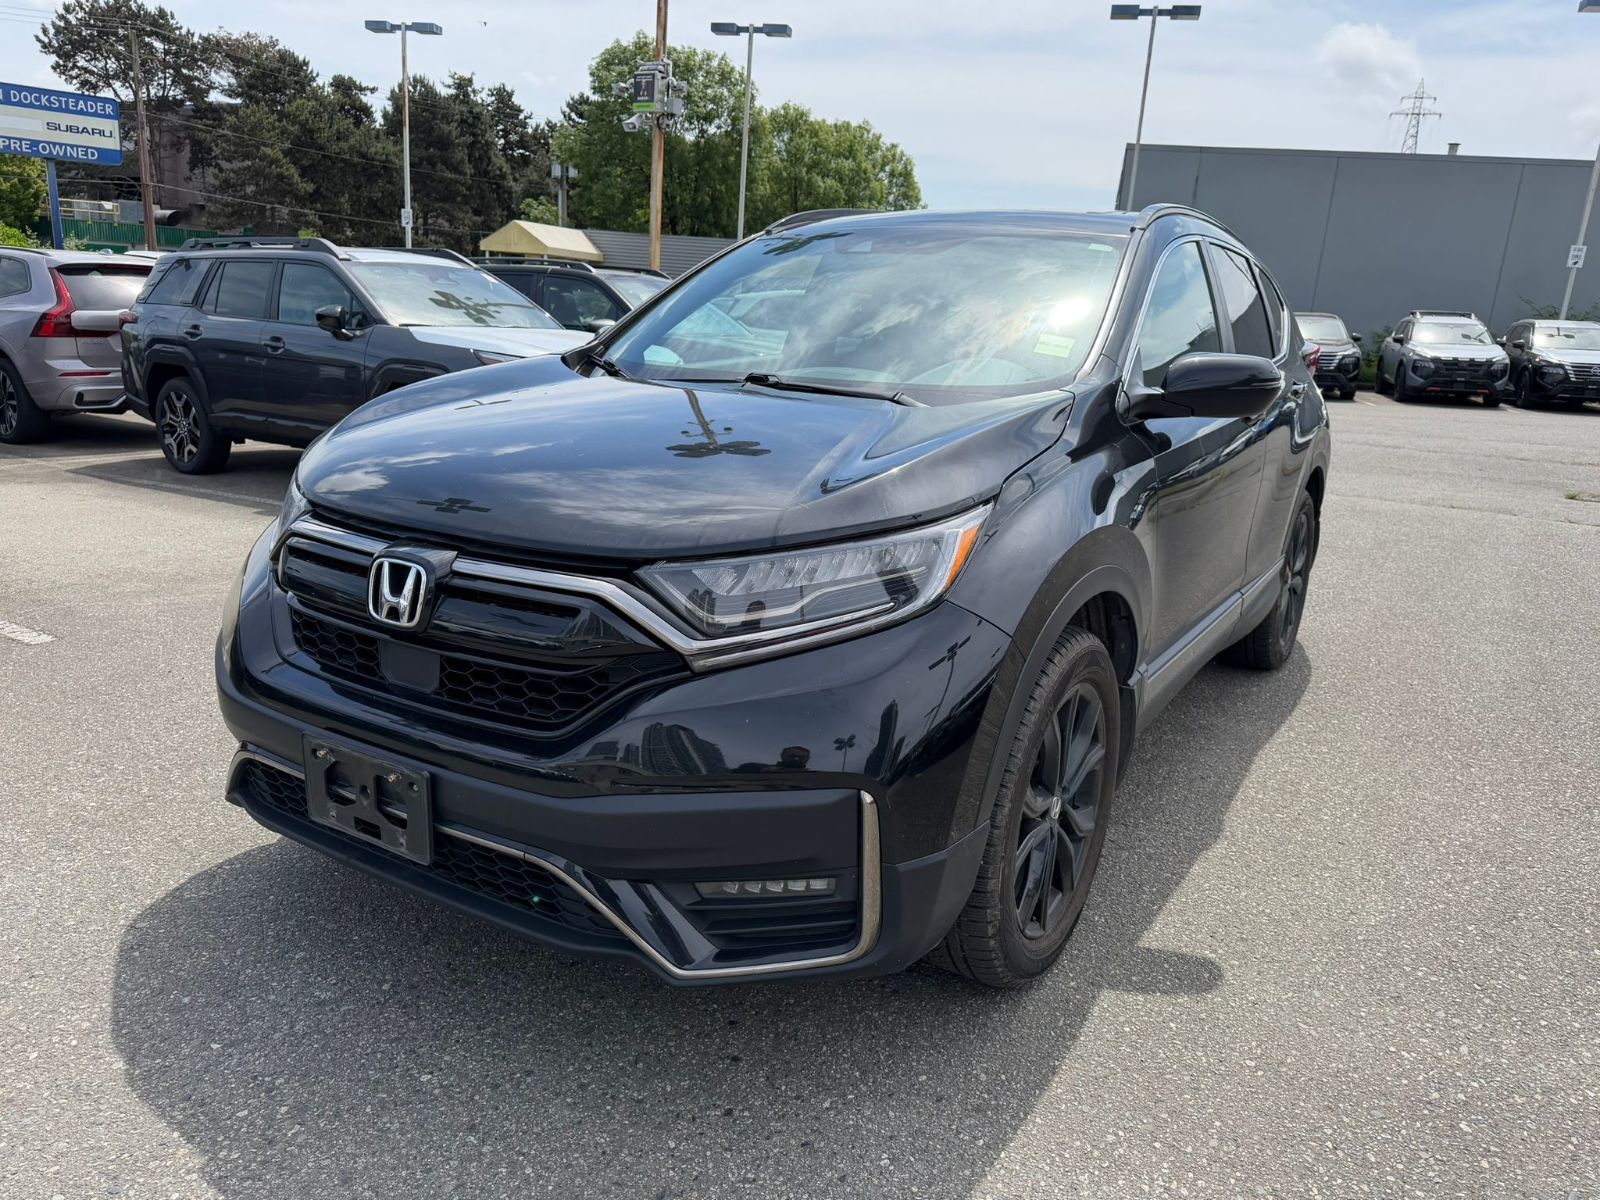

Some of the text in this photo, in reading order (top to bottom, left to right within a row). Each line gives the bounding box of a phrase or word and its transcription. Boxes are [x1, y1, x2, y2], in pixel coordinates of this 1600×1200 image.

[10, 90, 114, 115] DOCKSTEADER
[46, 121, 113, 138] SUBARU
[0, 138, 98, 160] PRE-OWNED
